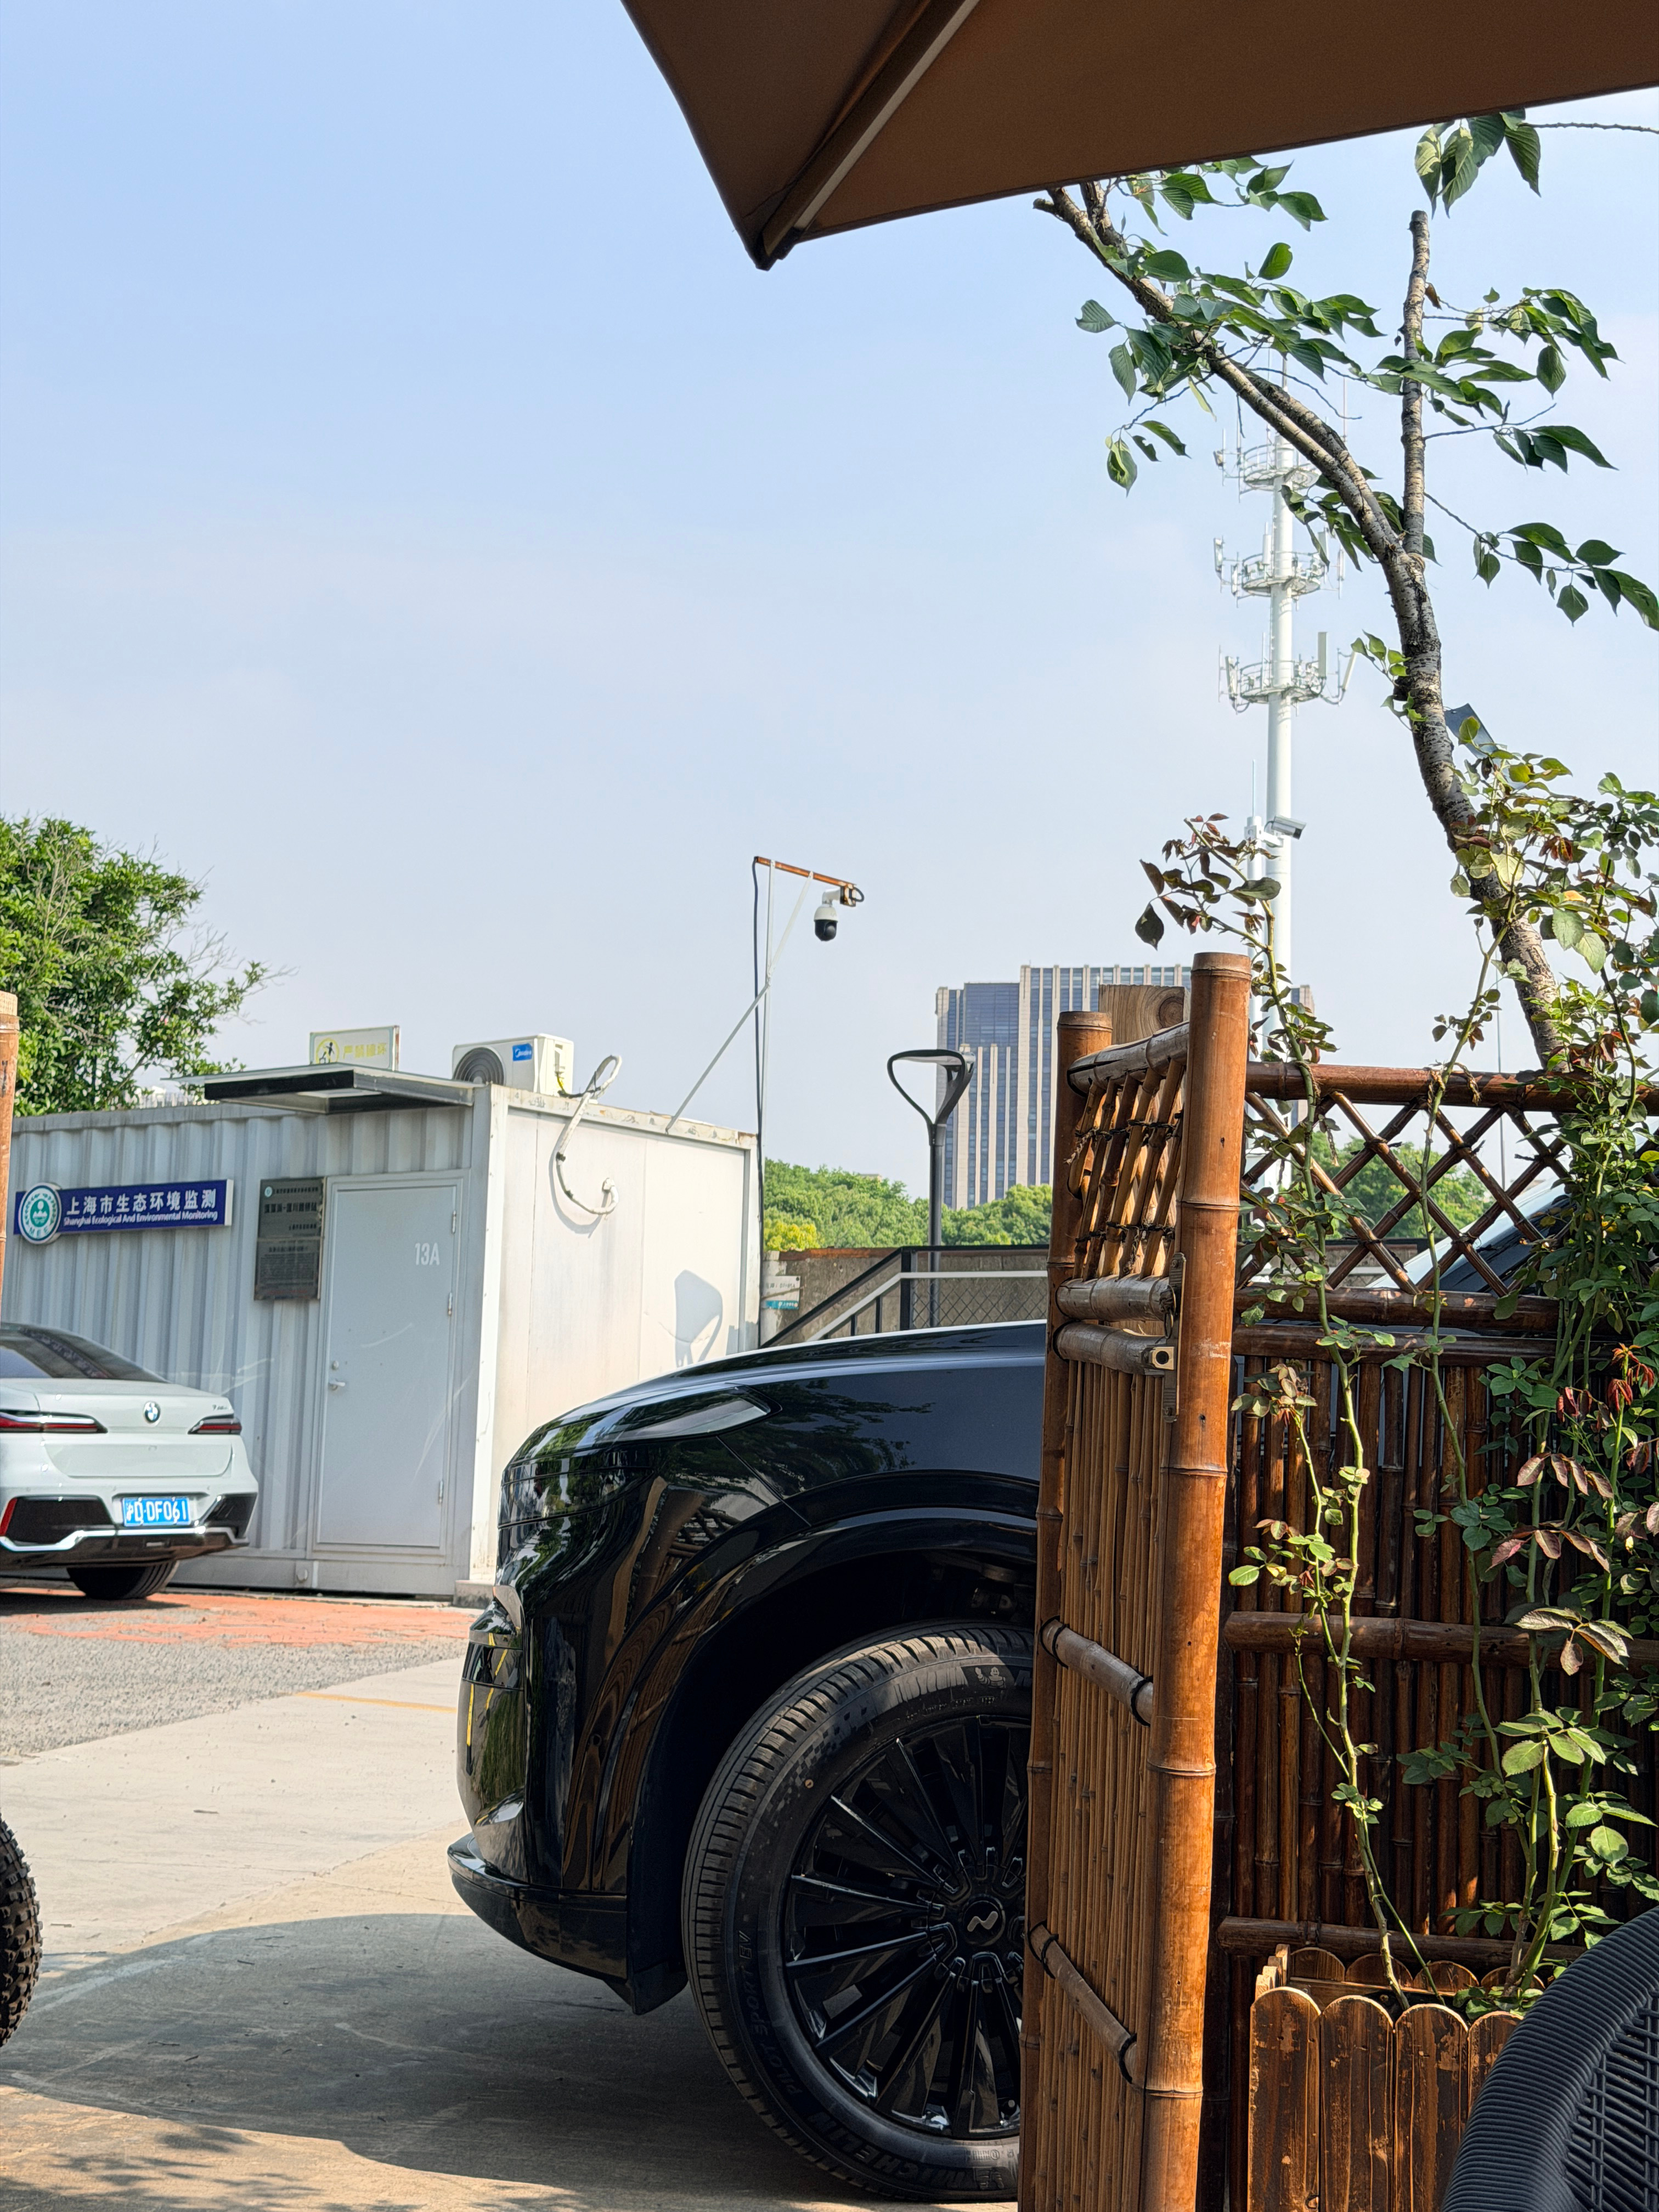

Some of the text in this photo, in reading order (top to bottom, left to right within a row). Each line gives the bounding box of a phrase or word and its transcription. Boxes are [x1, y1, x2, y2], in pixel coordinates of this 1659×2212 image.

[66, 1188, 216, 1215] 上海市生态环境监测
[64, 1209, 218, 1228] Shanghai Ecological And Environmental Monitoring
[415, 1243, 439, 1265] 13A
[807, 2110, 970, 2190] MICHELIN
